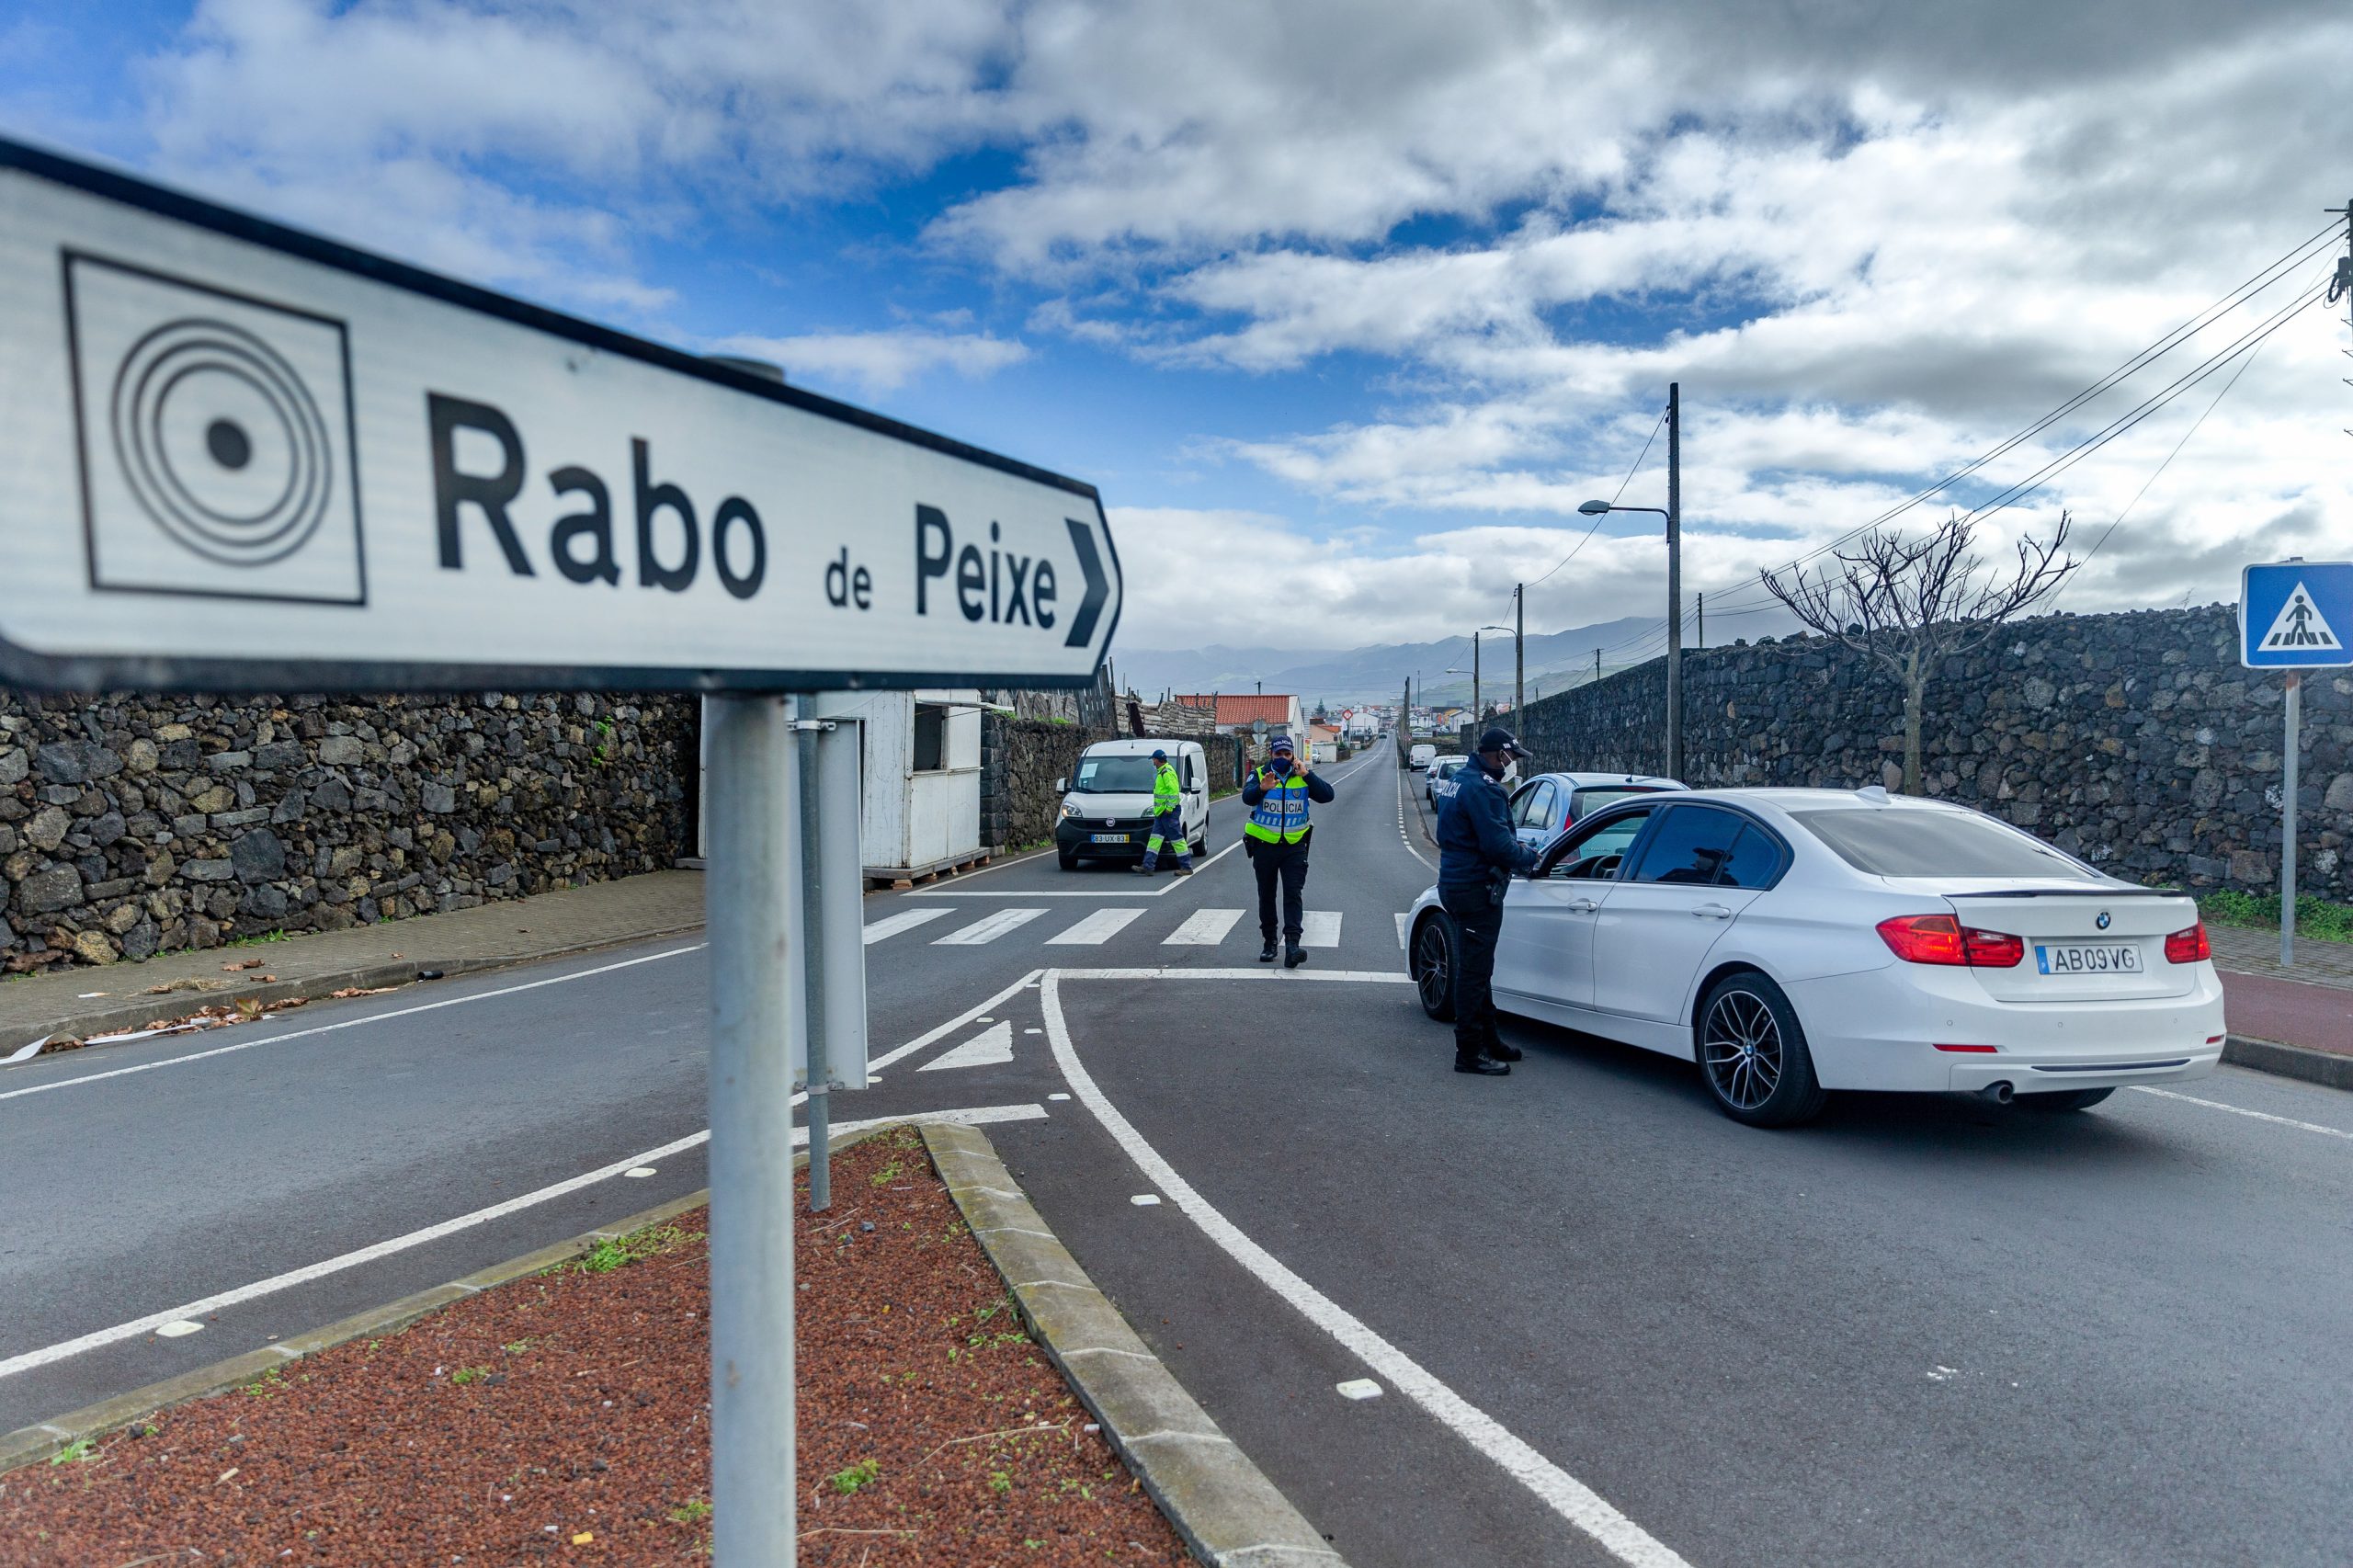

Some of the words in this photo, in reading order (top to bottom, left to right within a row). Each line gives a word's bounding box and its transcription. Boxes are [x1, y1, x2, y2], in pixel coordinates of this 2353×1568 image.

[424, 389, 768, 600] Rabo
[824, 546, 872, 611] de
[915, 502, 1058, 631] Peixe
[1264, 801, 1302, 813] POLÍCIA
